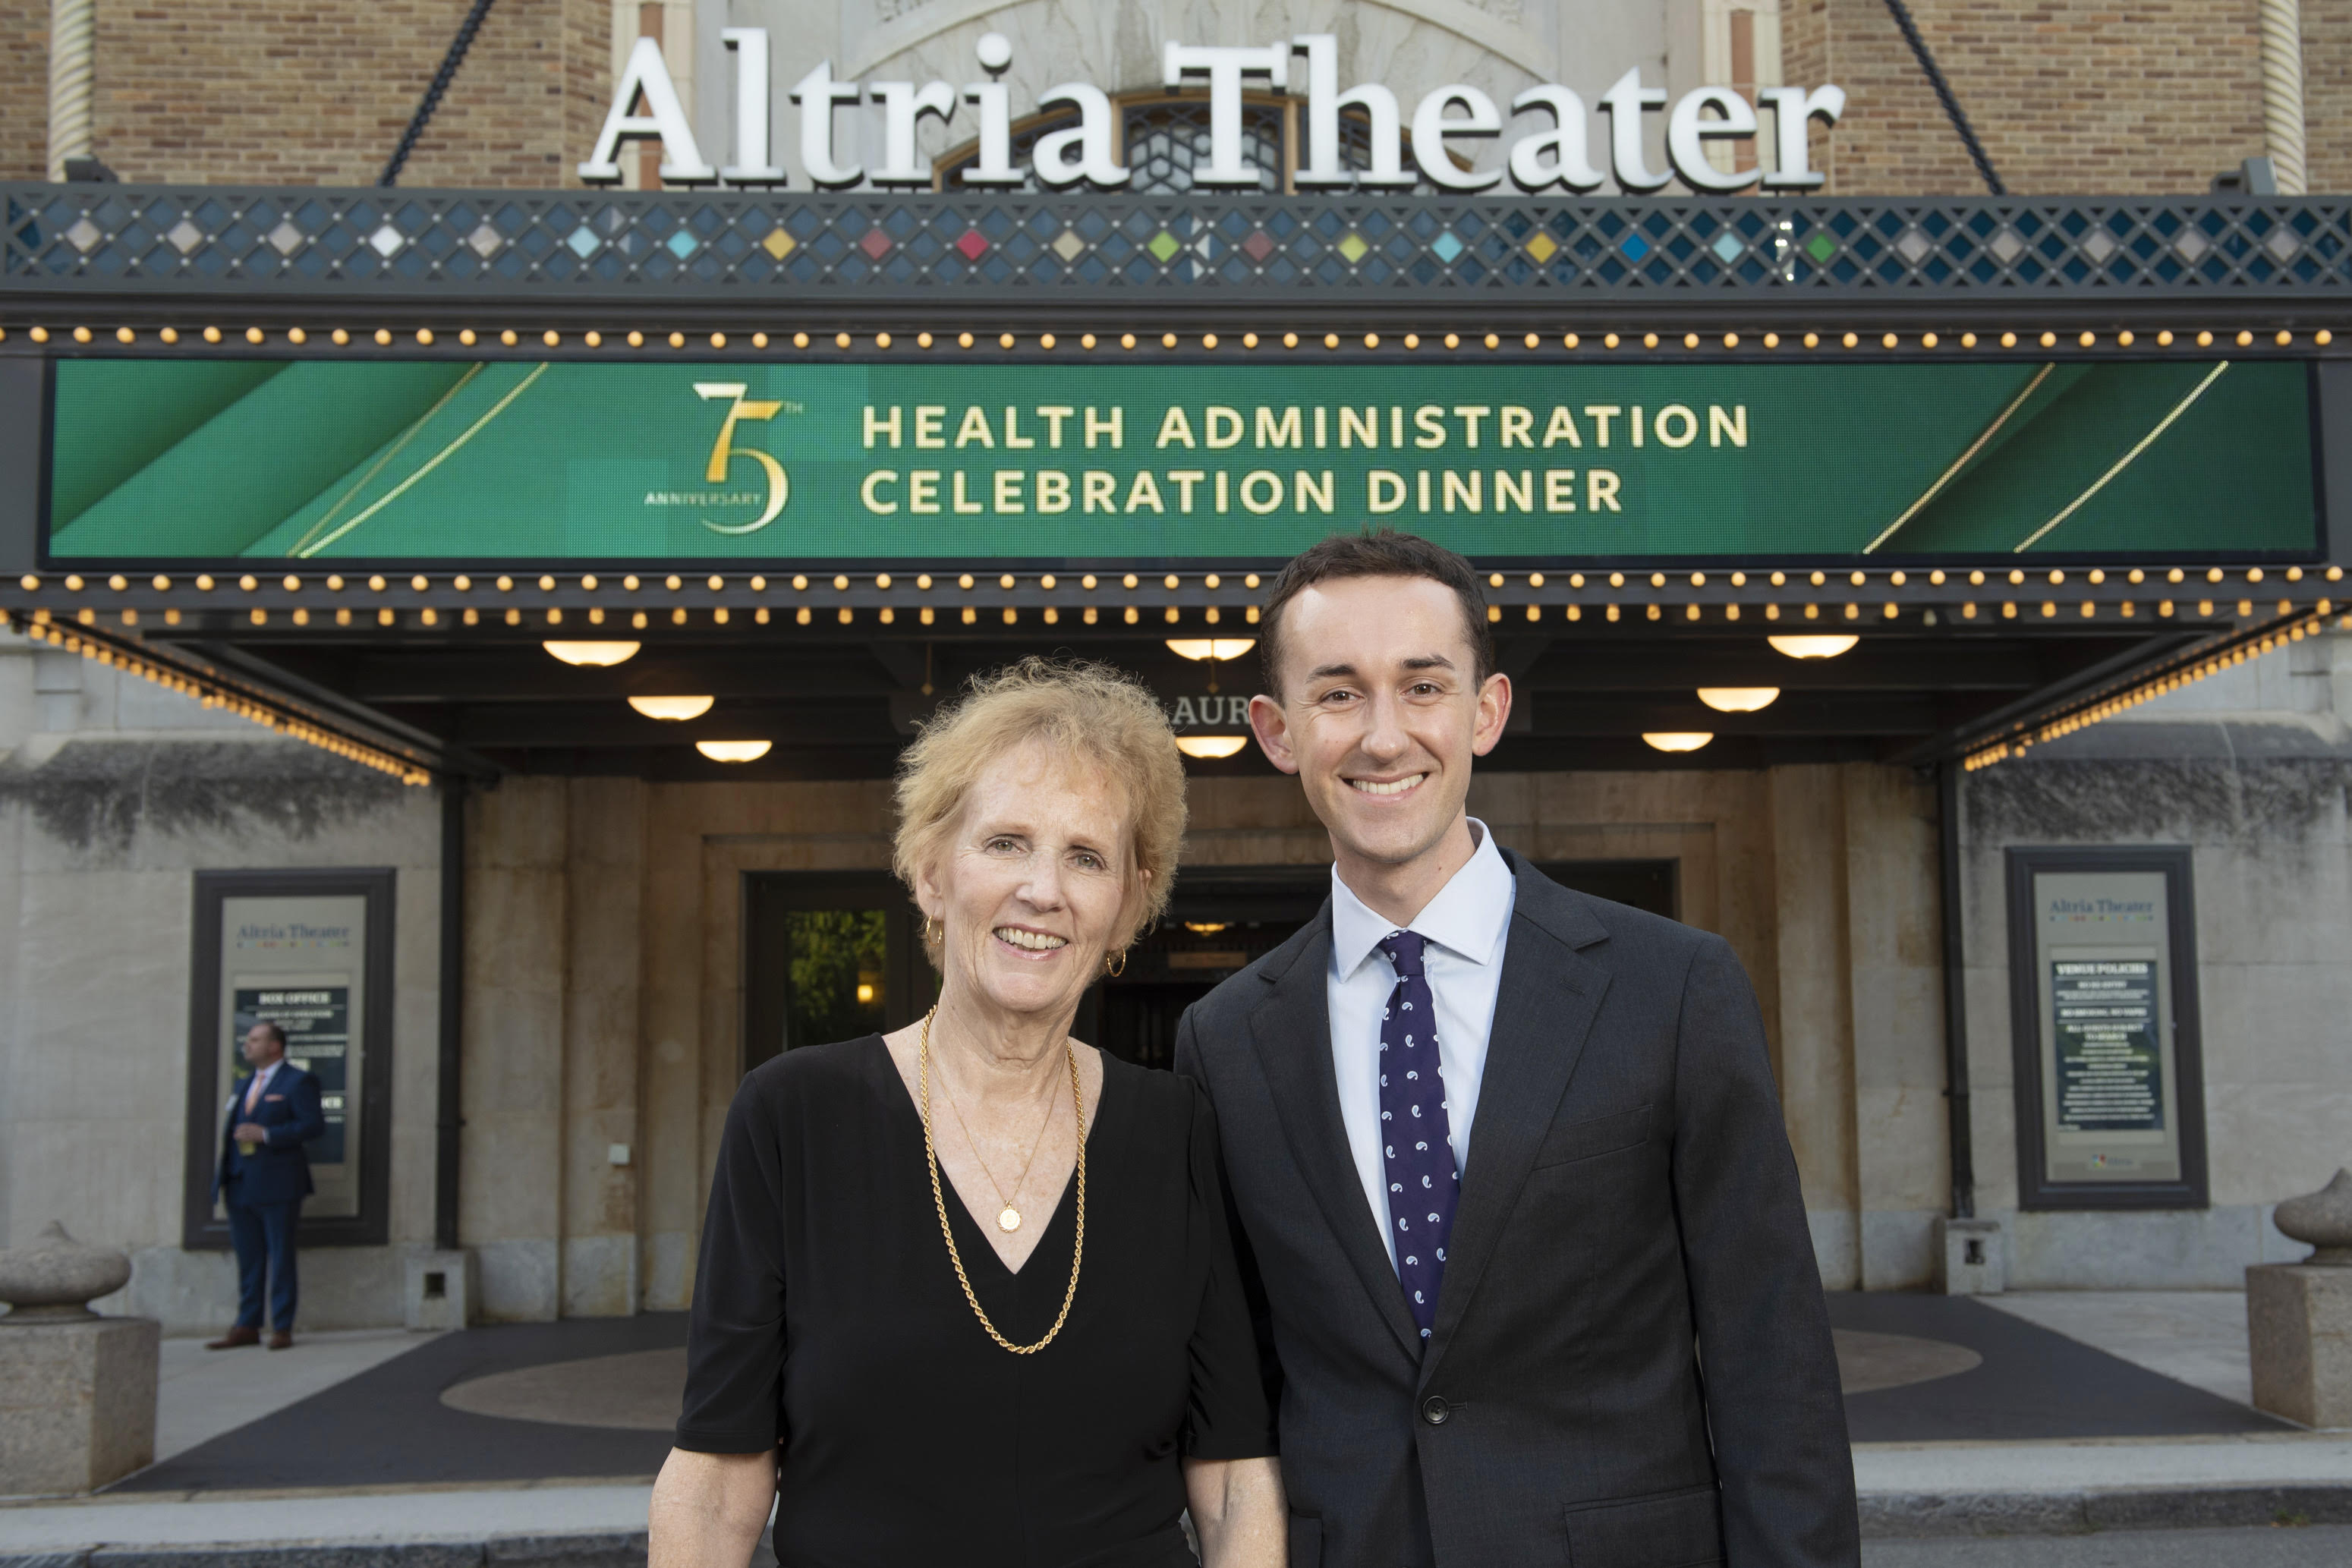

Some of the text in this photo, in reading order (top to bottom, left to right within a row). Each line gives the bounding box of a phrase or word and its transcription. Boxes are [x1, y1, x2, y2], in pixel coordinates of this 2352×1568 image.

[576, 27, 1847, 190] Altria Theater
[862, 405, 1749, 450] HEALTH ADMINISTRATION
[644, 490, 763, 506] ANNIVERSARY
[859, 468, 1623, 515] CELEBRATION DINNER
[2050, 898, 2154, 913] Altria Theater
[237, 923, 350, 940] Altria Theater
[2056, 962, 2149, 975] VENUE POLICIES
[258, 991, 332, 1004] BOX OFFICE
